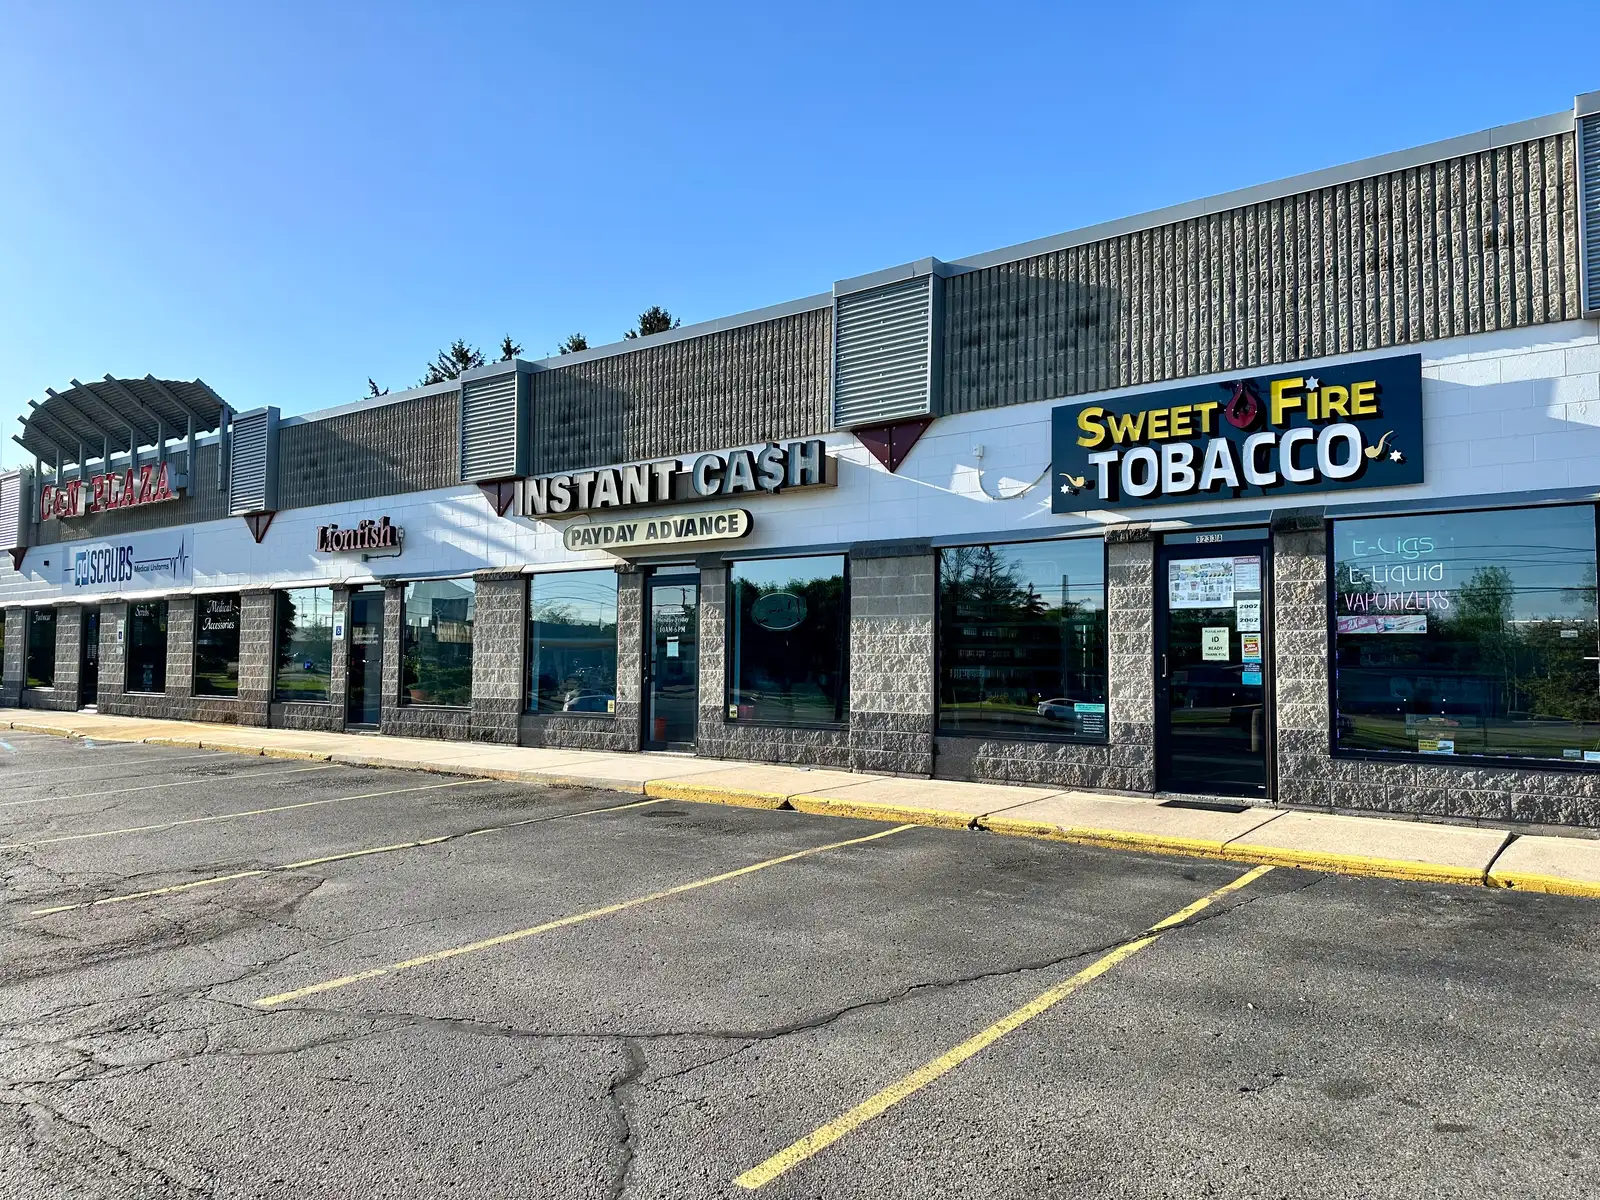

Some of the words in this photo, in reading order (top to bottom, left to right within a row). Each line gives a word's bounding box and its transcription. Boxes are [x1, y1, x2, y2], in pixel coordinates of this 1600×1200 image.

[1076, 400, 1219, 448] SWEET
[1270, 376, 1379, 426] FIRE
[512, 459, 680, 517] INSTANT
[692, 438, 826, 494] CA$H
[1088, 422, 1363, 501] TOBACCO
[40, 479, 87, 522] C&N
[90, 460, 173, 514] PLAZA
[316, 515, 392, 553] Lionfish
[570, 522, 639, 548] PAYDAY
[644, 512, 740, 541] ADVANCE
[90, 545, 134, 585] SCRUBS
[134, 564, 149, 573] Medical
[150, 562, 169, 573] Uniforms
[1349, 562, 1443, 587] E-Liquid
[206, 599, 233, 613] Medical
[1344, 590, 1450, 611] VAPORIZERS
[202, 617, 235, 631] Accessories
